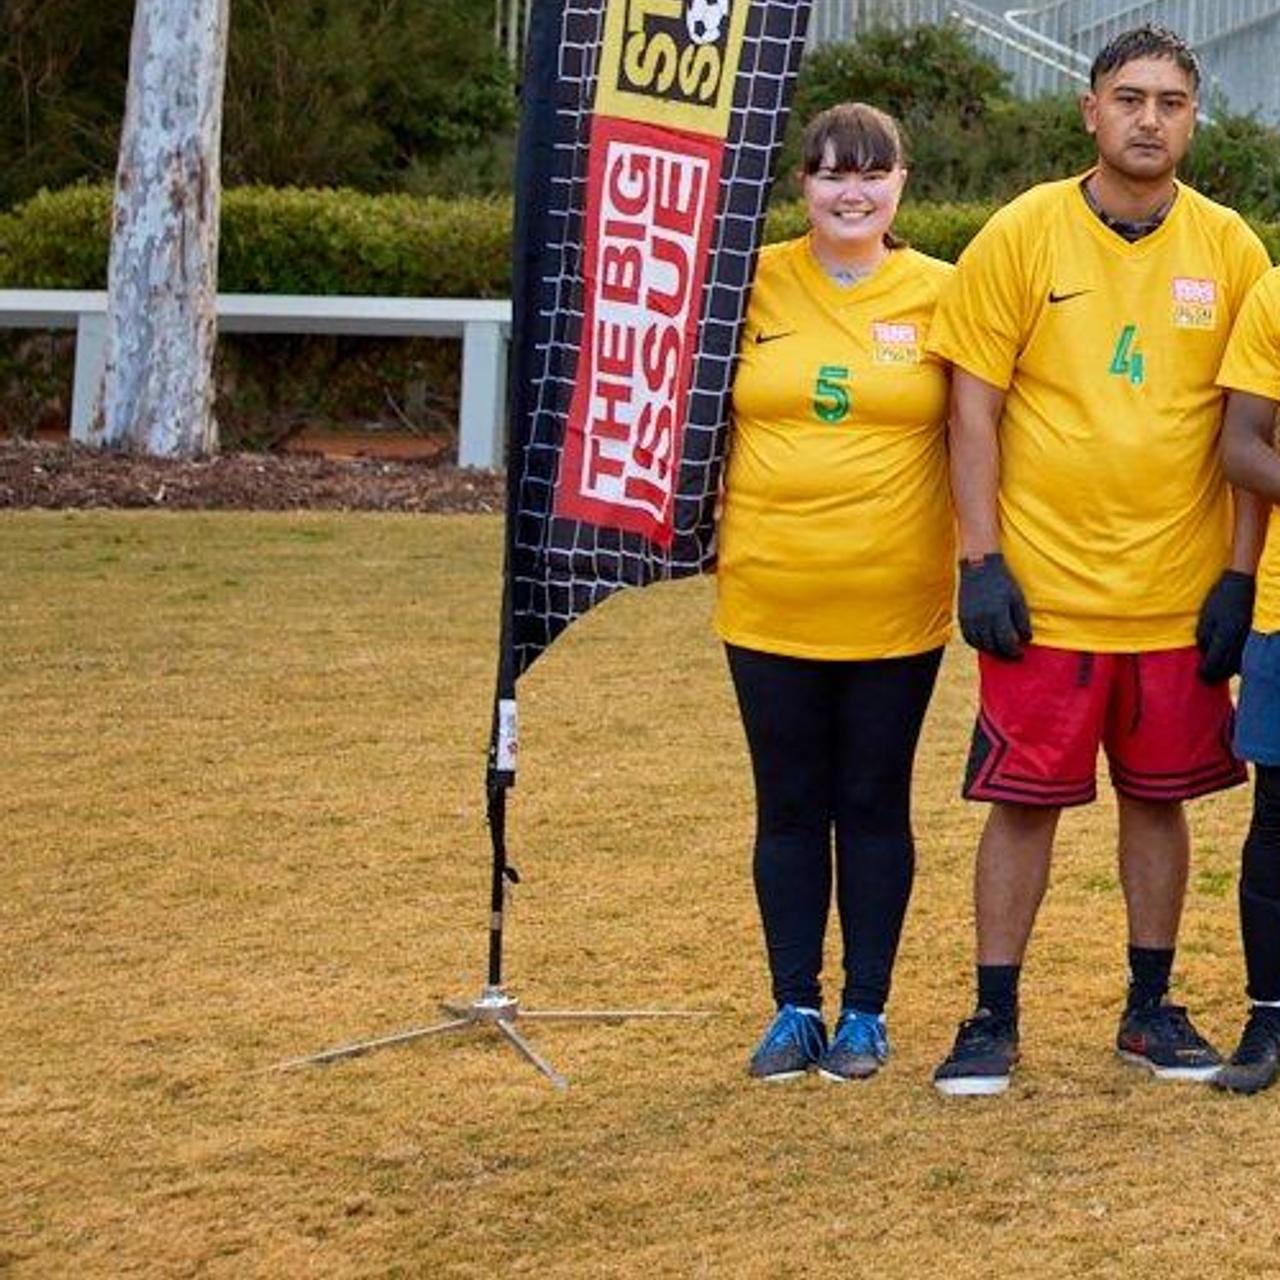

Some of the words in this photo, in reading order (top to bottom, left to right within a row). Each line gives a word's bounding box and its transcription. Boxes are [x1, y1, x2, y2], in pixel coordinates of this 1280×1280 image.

[603, 152, 652, 305] BIG
[589, 325, 636, 493] THE
[624, 162, 704, 521] ISSUE
[814, 366, 849, 420] 5
[1109, 324, 1144, 384] 4
